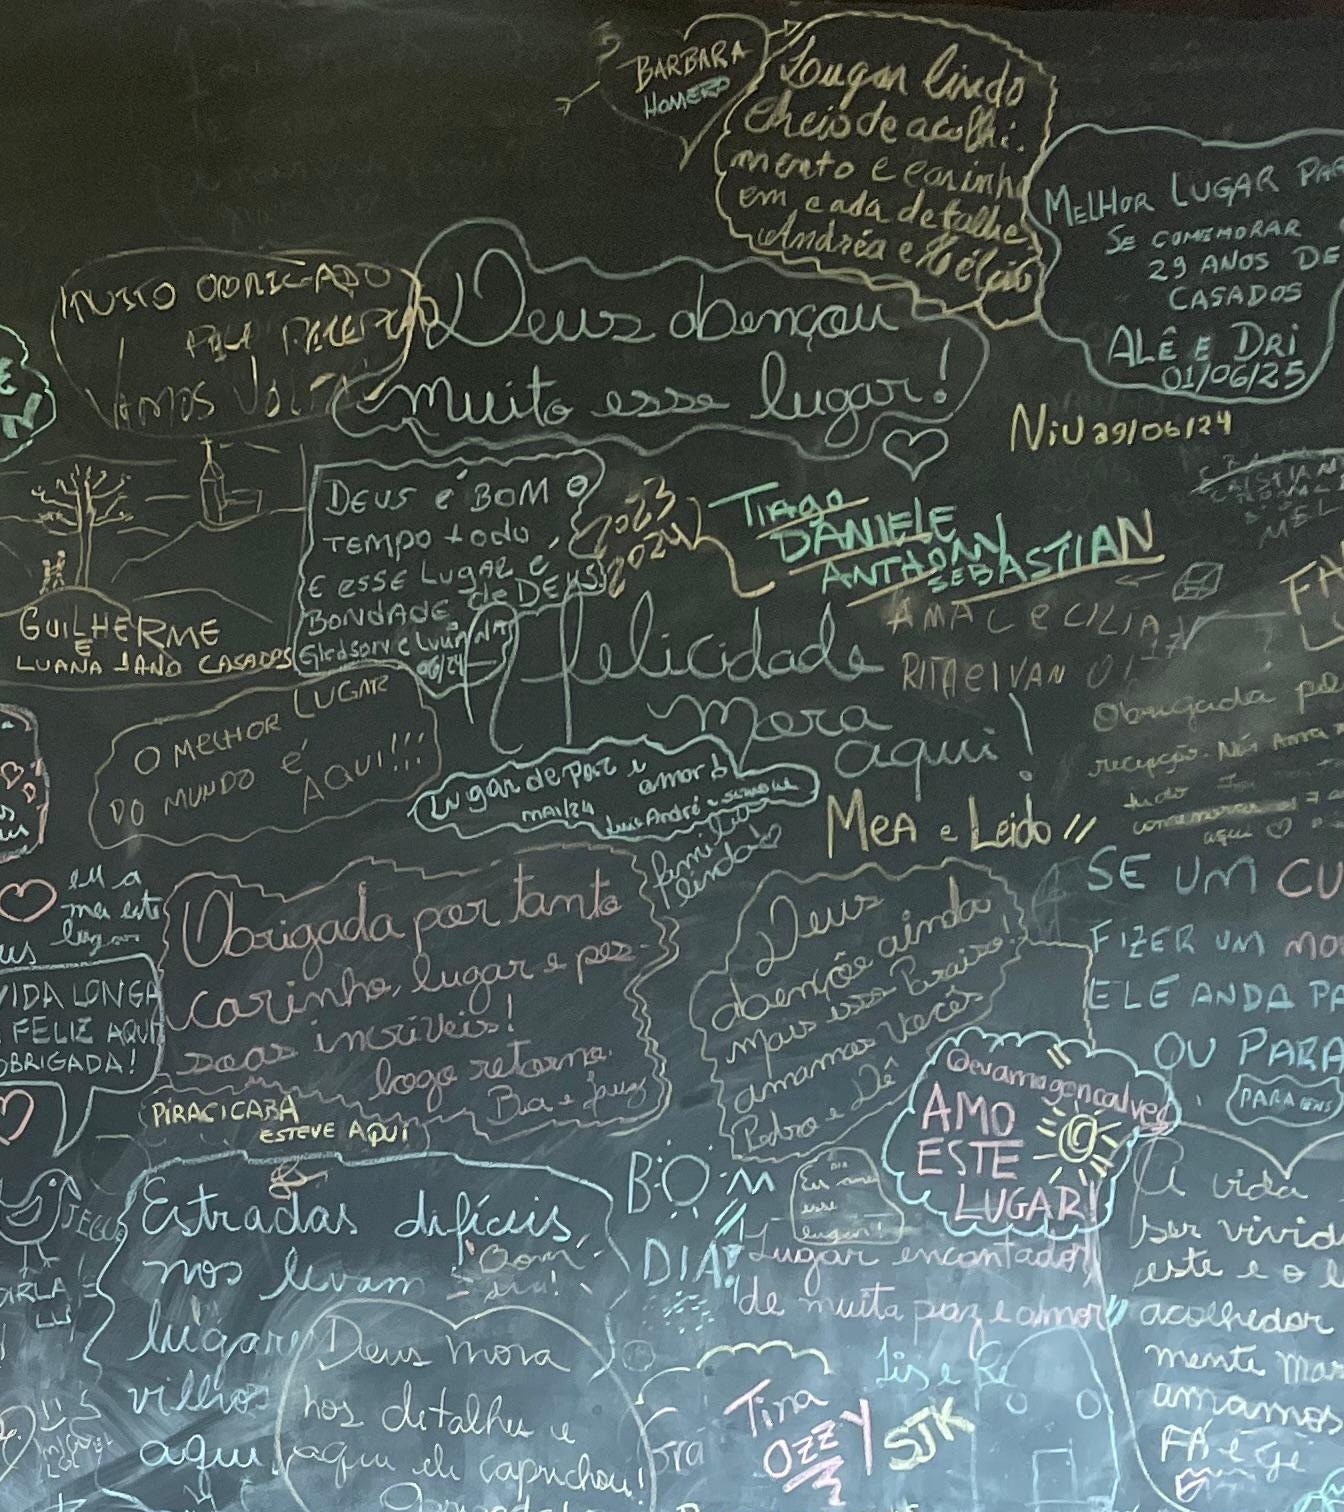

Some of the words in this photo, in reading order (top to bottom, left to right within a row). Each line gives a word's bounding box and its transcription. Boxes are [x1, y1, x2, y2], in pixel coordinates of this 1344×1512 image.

[856, 104, 898, 144] de
[871, 155, 898, 182] e
[1172, 165, 1280, 207] LUGAR
[739, 186, 788, 209] em
[804, 190, 883, 224] cada
[1151, 218, 1302, 249] COMEMORAR
[1148, 258, 1188, 281] 29
[1200, 251, 1270, 275] ANOS
[1293, 245, 1341, 270] DE
[1169, 282, 1303, 312] CASADOS
[1108, 324, 1178, 368] ALÊ
[1161, 360, 1307, 393] 01/06/25
[589, 388, 730, 418] esse
[325, 479, 417, 515] DEUS
[470, 477, 549, 511] BOM
[322, 528, 433, 560] TEMPO
[771, 498, 958, 564] DANIELE
[927, 508, 1154, 594] SEBASTIAN
[822, 513, 1006, 594] ANTHONY
[19, 605, 221, 650] GUILHERME
[17, 658, 103, 676] LUANA
[199, 647, 294, 674] CASADOS
[134, 745, 161, 775] O
[111, 798, 145, 827] DO
[164, 770, 255, 816] MUNDO
[1088, 845, 1151, 891] SE
[1176, 855, 1256, 895] UM
[182, 881, 406, 981] Obrigada
[413, 899, 501, 953] por
[756, 894, 885, 976] Deus
[1090, 919, 1196, 958] FIZER
[1215, 929, 1265, 956] UM
[73, 979, 161, 1009] LONGA
[411, 952, 534, 1014] lugar
[1089, 973, 1180, 1010] ELE
[1191, 981, 1295, 1013] ANDA
[12, 1016, 93, 1044] FELIZ
[1154, 1031, 1217, 1070] OU
[368, 1057, 458, 1110] logo
[922, 1082, 1016, 1137] AMO
[258, 1121, 335, 1145] ESTEVE
[731, 1113, 818, 1154] Pedro
[916, 1138, 1023, 1180] ESTE
[1213, 1168, 1308, 1200] vida
[141, 1176, 359, 1237] Estradas
[724, 1378, 829, 1437] Tina
[762, 1398, 873, 1478] OZZY
[884, 1397, 976, 1472] SJK
